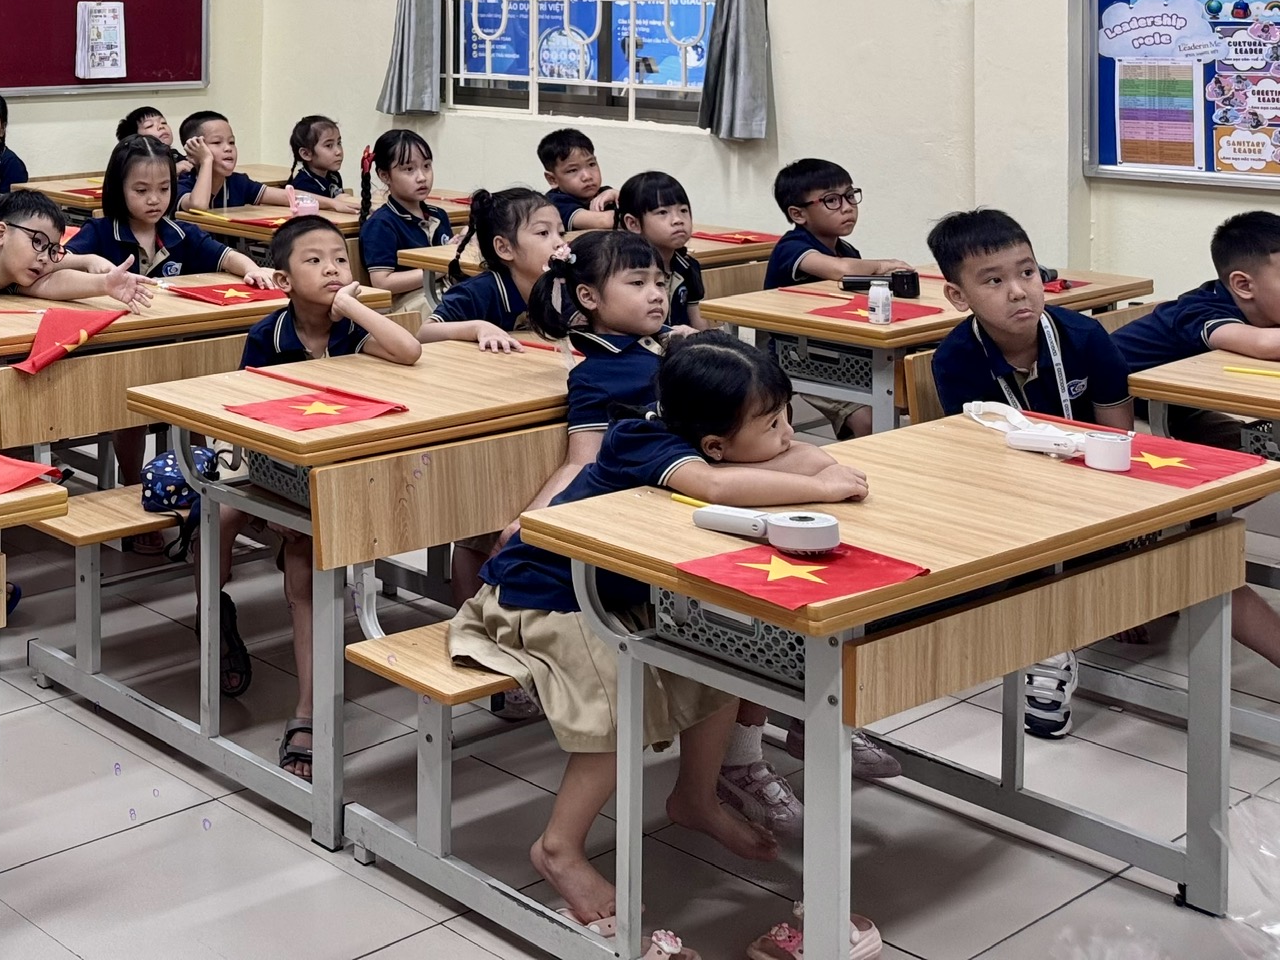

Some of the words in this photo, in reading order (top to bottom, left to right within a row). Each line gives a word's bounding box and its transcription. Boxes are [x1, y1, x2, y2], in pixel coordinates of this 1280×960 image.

[547, 2, 565, 13] VIỆT
[1104, 13, 1188, 40] Leadership
[1131, 32, 1172, 50] role
[1226, 140, 1266, 148] SANITARY
[1233, 147, 1262, 155] LEADER
